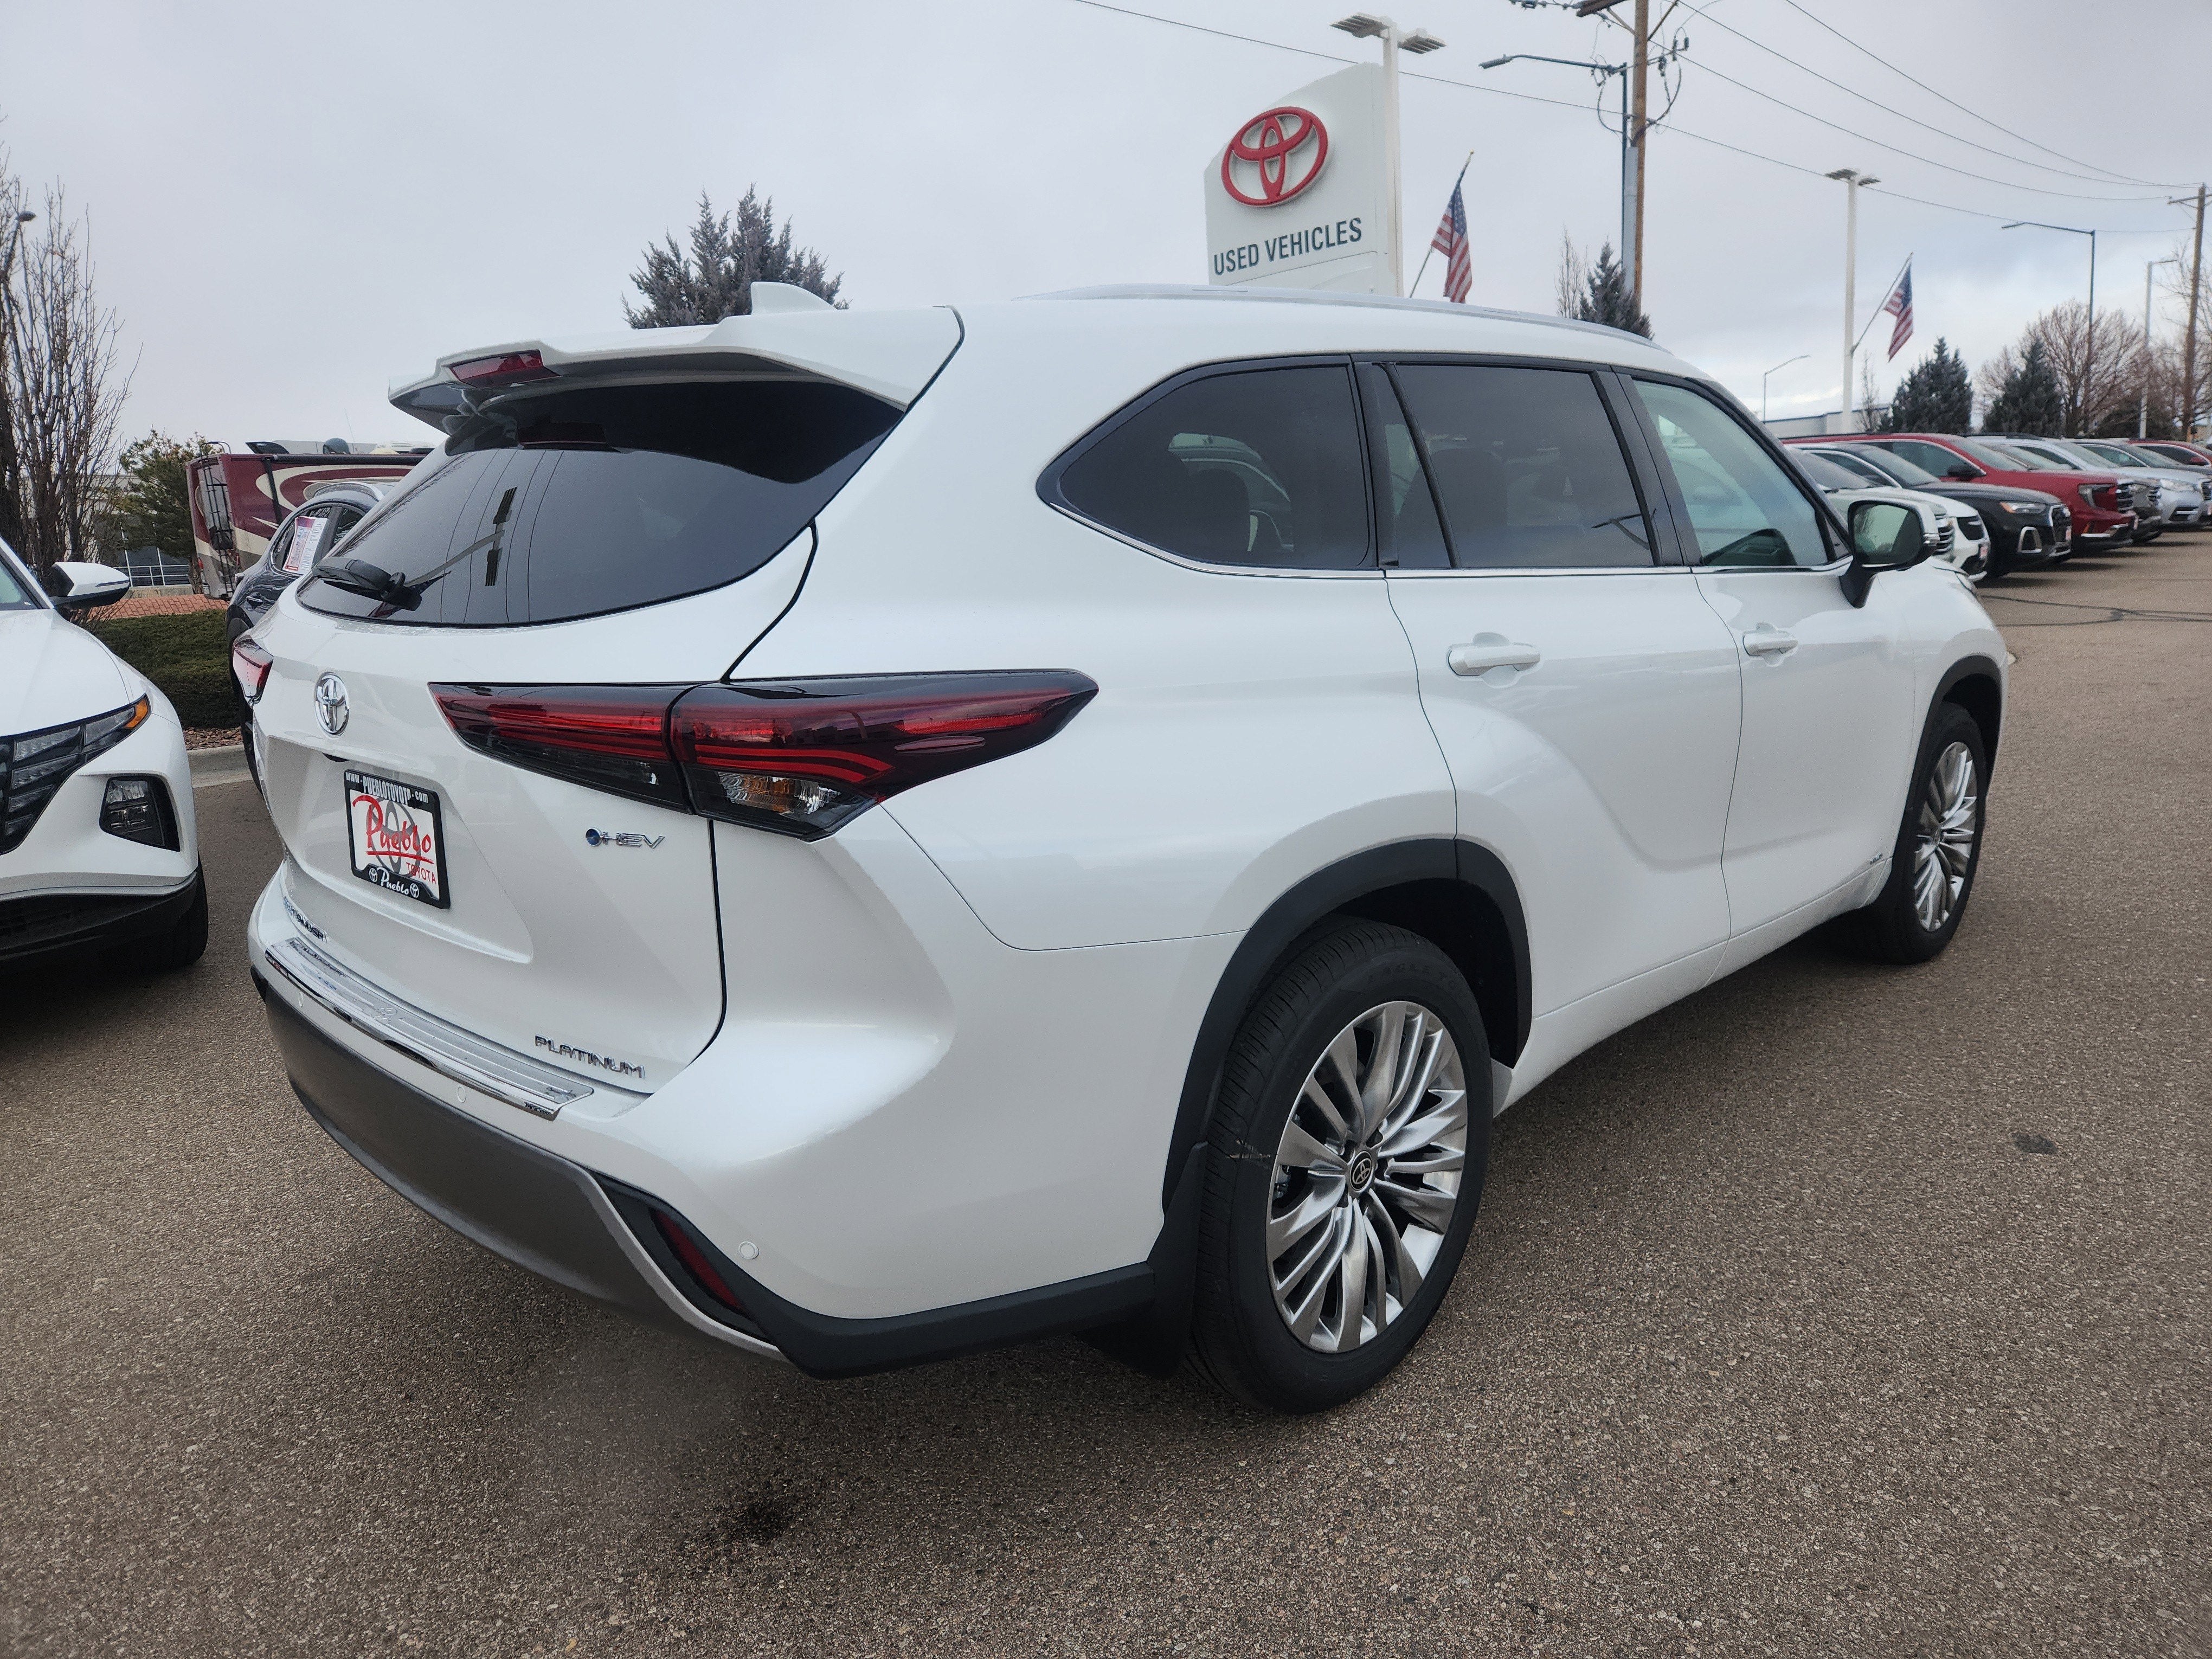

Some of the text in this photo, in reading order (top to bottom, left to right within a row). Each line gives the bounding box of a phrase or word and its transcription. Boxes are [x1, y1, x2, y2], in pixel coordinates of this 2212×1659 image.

[1213, 217, 1362, 276] USED VEHICLES
[352, 795, 432, 853] Pueblo
[376, 867, 409, 896] Pueblo
[406, 862, 437, 885] TOYOTA
[535, 1034, 646, 1079] PLATINUM
